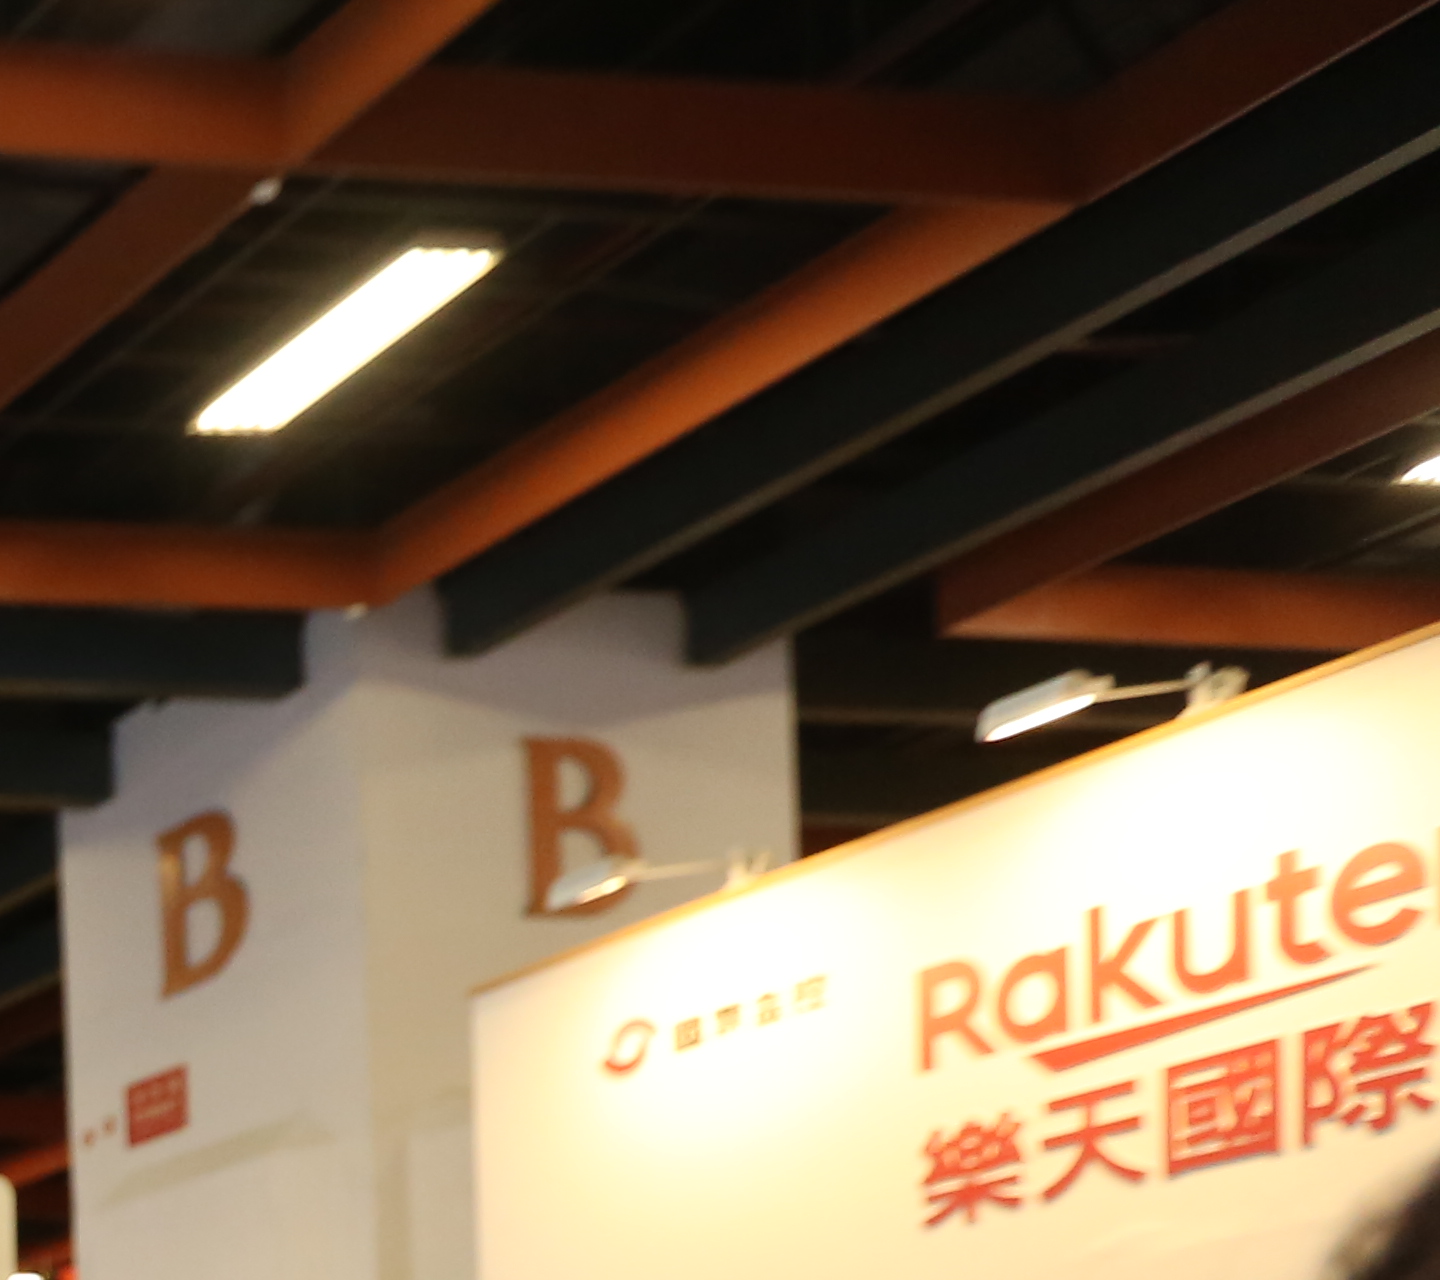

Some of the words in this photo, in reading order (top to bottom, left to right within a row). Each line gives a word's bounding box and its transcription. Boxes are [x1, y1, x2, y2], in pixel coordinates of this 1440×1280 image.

[156, 810, 250, 999] B
[518, 734, 641, 918] B
[912, 827, 1440, 1073] Rakute
[918, 1001, 1440, 1230] 樂天國際
